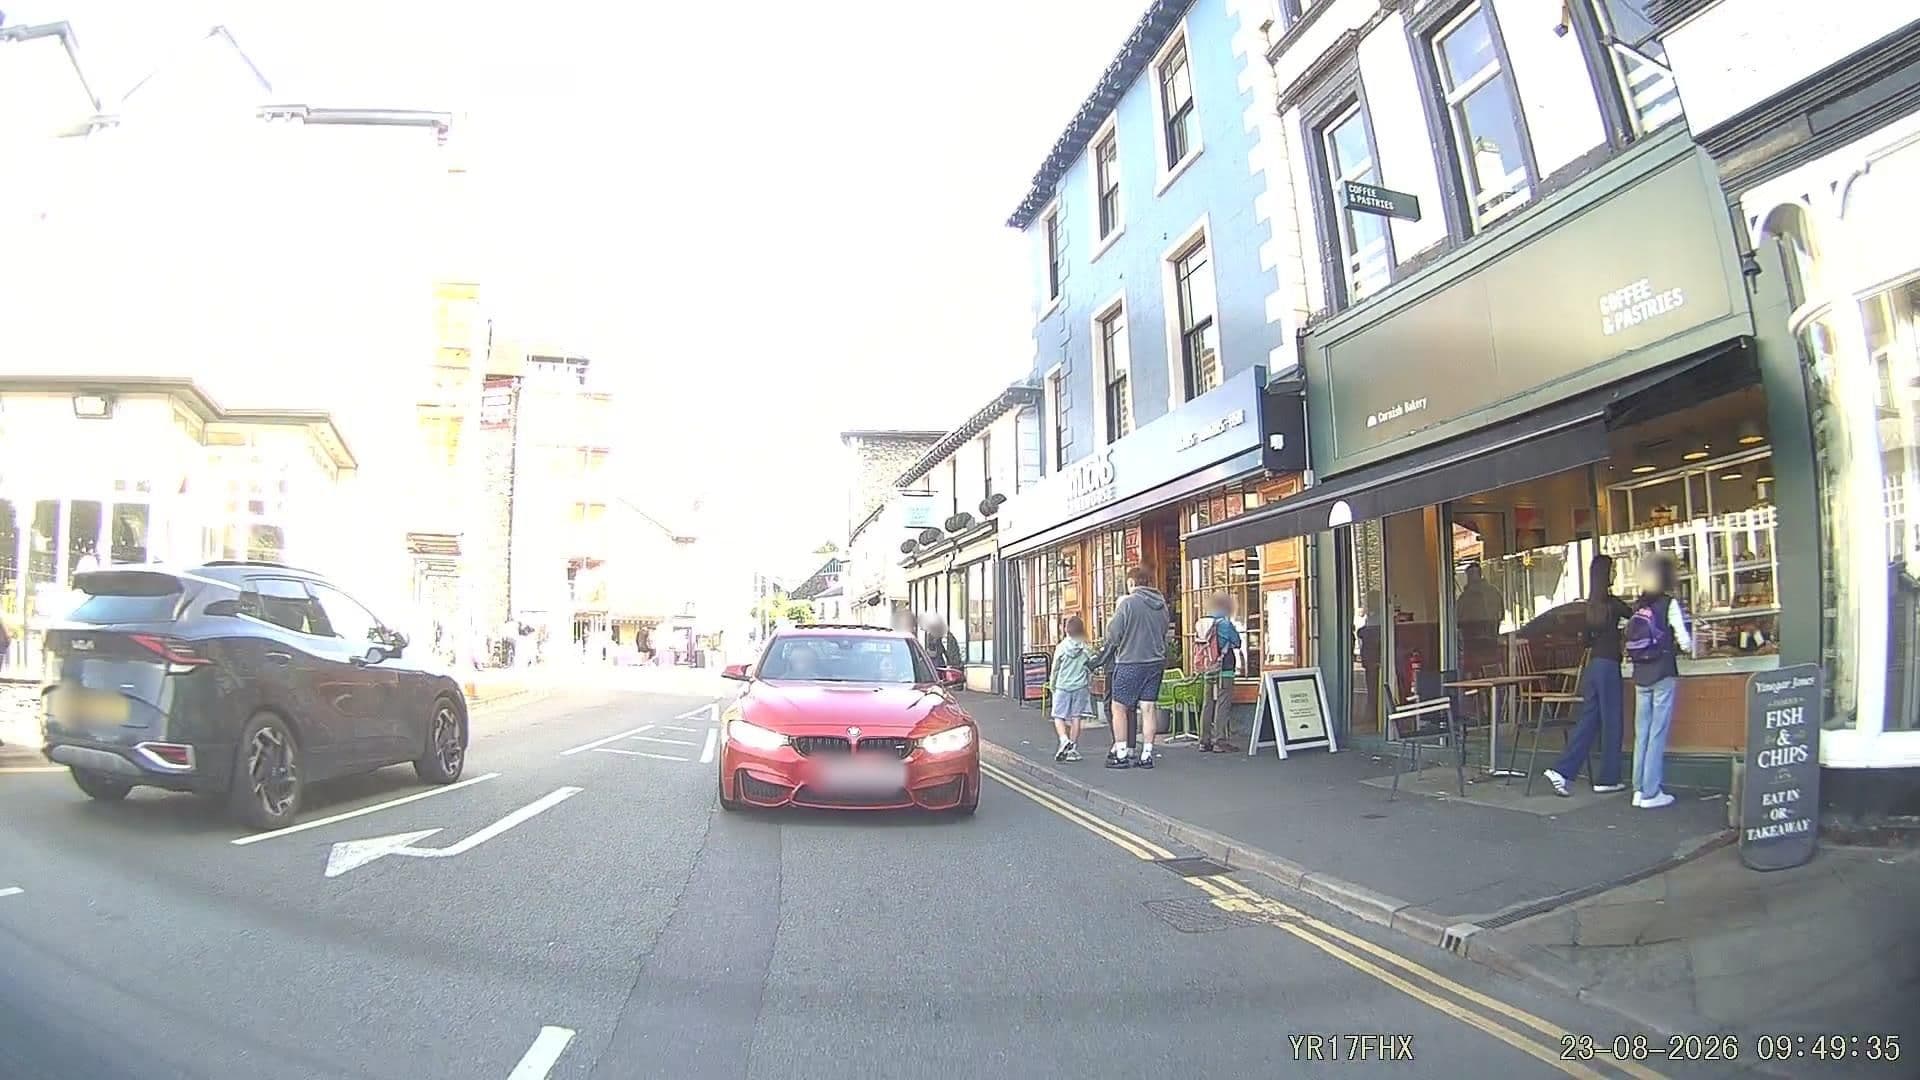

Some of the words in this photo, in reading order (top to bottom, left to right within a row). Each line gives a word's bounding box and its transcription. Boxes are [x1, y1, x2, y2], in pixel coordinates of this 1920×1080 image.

[1348, 184, 1377, 198] COFFEE
[1356, 194, 1394, 210] PASTRIES
[1600, 278, 1651, 315] COFFEE
[1378, 404, 1403, 423] Cornish
[1404, 398, 1427, 414] Bakery
[1766, 706, 1804, 729] FISH
[1777, 729, 1791, 746] &
[1757, 744, 1809, 769] CHIPS
[1762, 791, 1786, 806] EAT
[1786, 788, 1801, 802] IN
[1770, 808, 1789, 821] OR
[1746, 818, 1812, 841] TAKEAWAY
